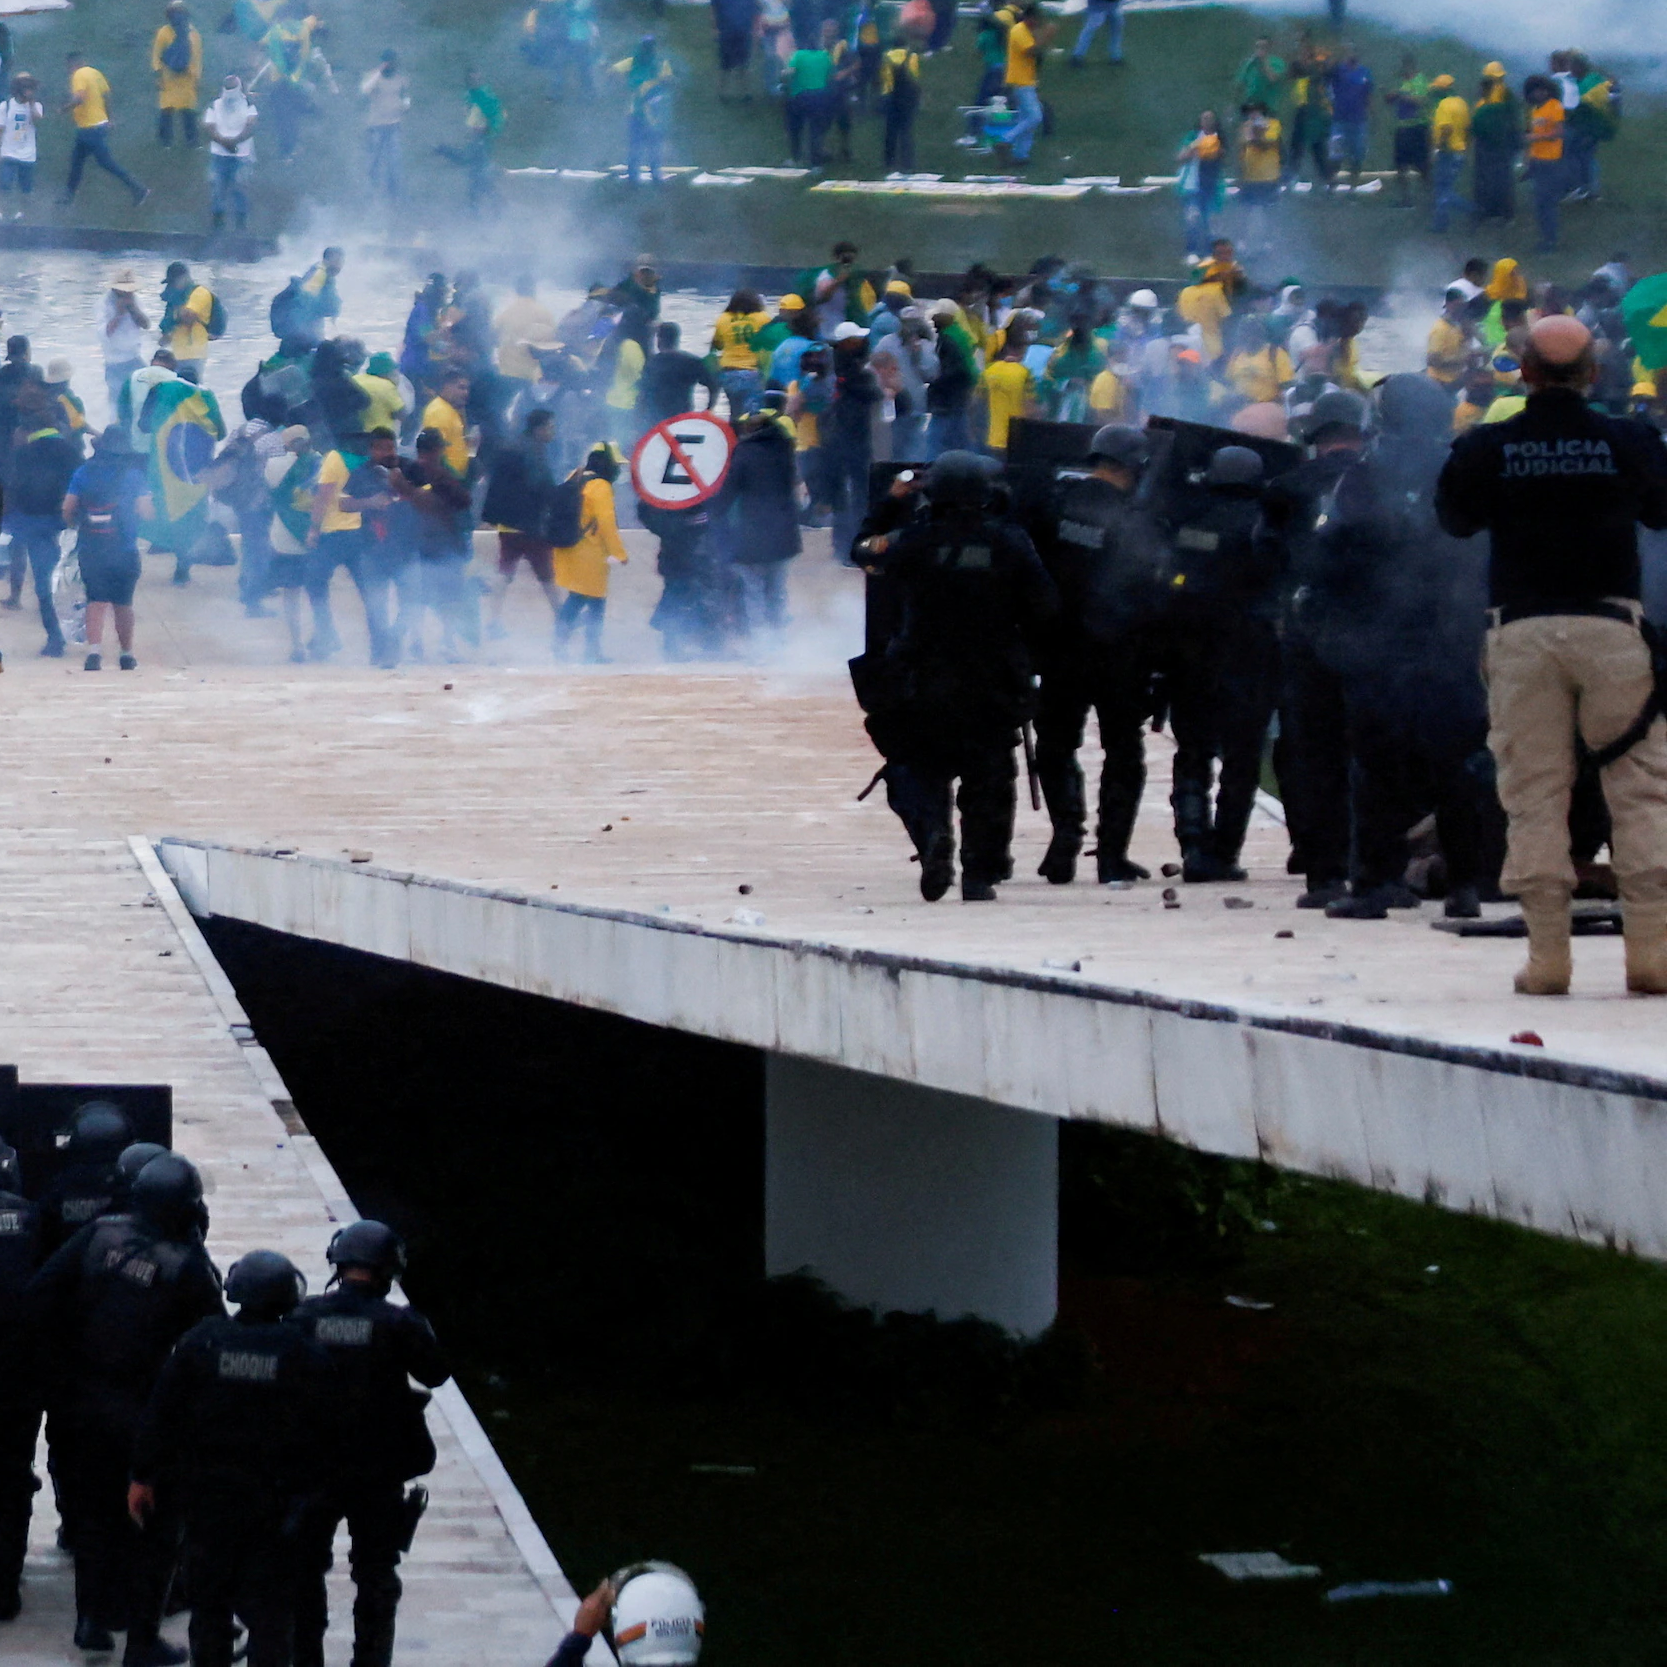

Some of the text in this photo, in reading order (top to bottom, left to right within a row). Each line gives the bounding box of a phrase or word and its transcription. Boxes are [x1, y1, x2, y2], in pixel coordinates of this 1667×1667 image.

[661, 434, 705, 484] E
[1498, 457, 1617, 476] JUDICIAL
[218, 1352, 279, 1380] CHOQUE
